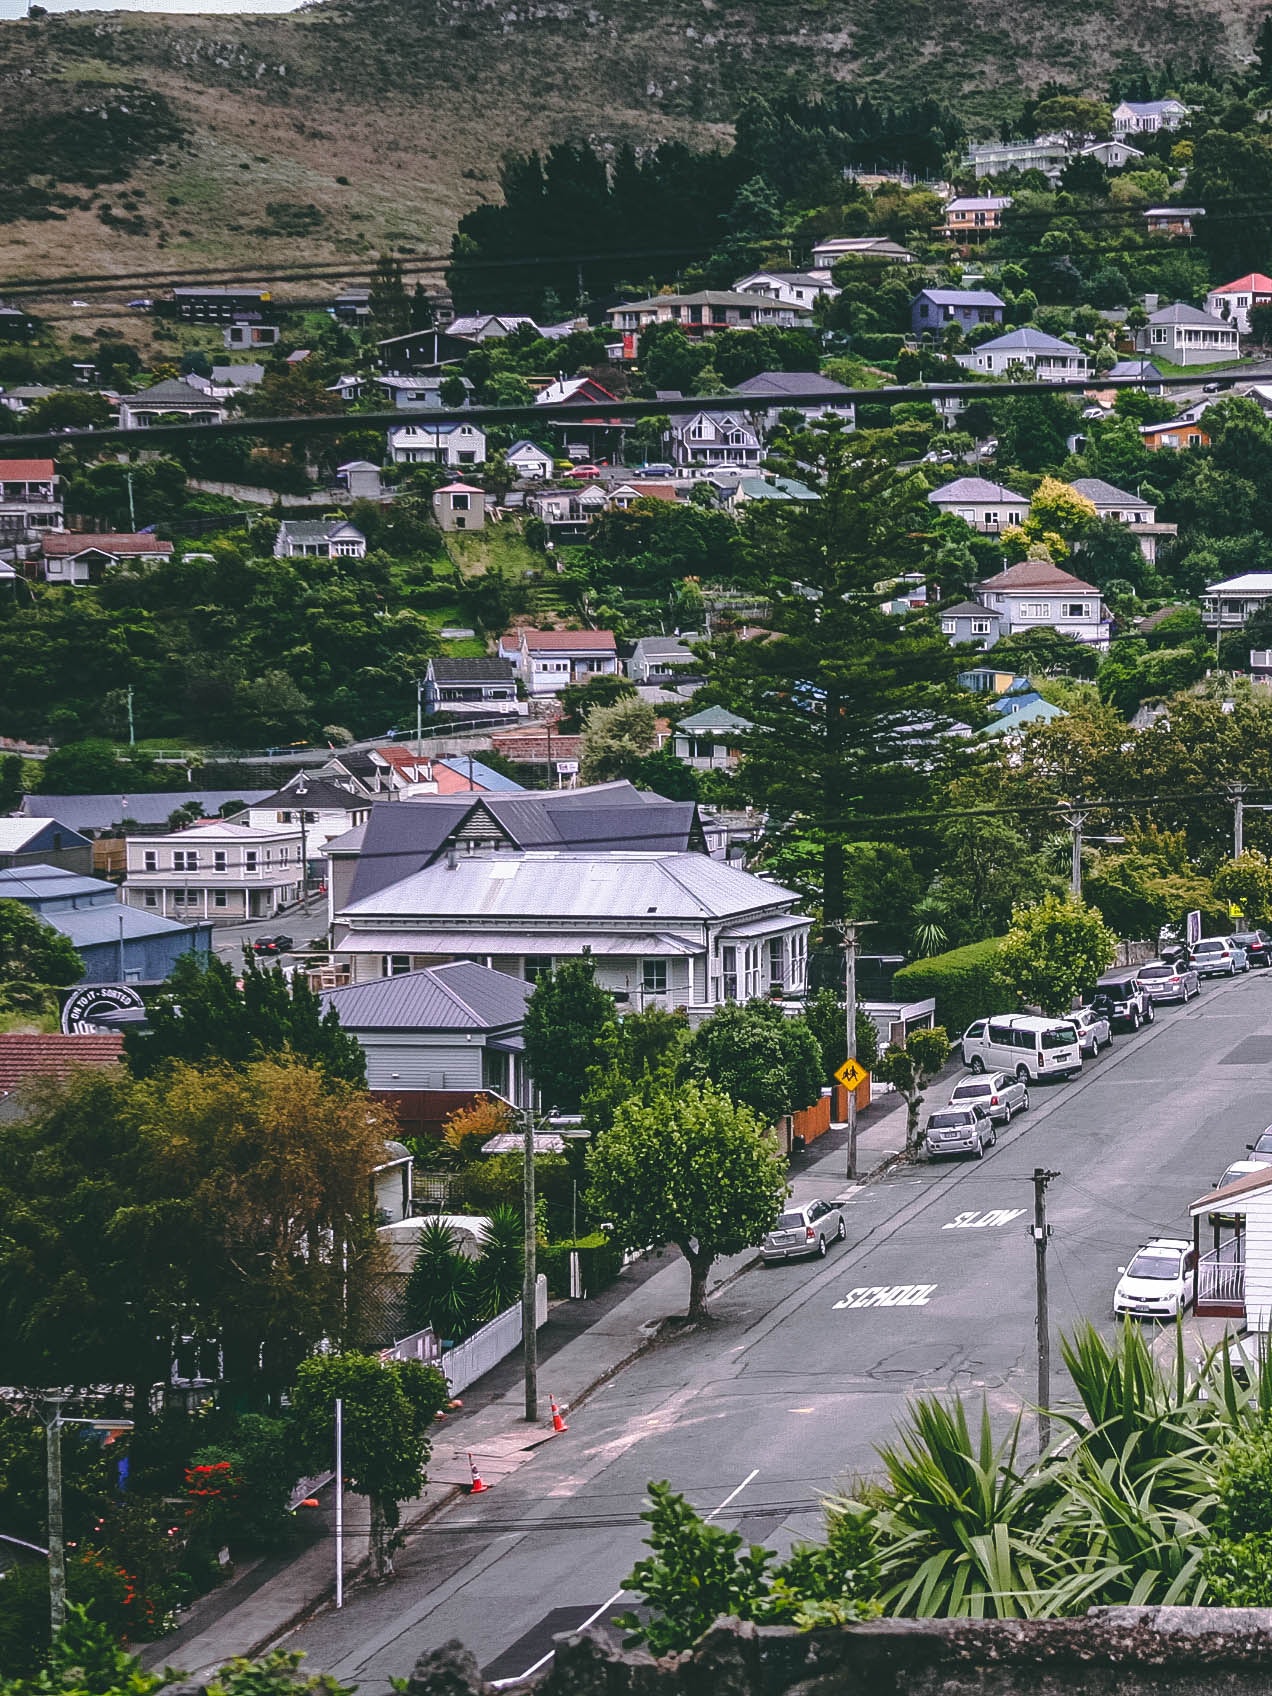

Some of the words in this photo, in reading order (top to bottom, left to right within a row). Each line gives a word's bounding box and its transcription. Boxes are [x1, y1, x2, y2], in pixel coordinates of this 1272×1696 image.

[70, 1006, 82, 1019] ON
[77, 996, 88, 1007] TO
[87, 991, 96, 1000] IT
[101, 988, 132, 1005] SORTED
[942, 1208, 1028, 1229] SLOW
[832, 1284, 938, 1309] SCHOOL
